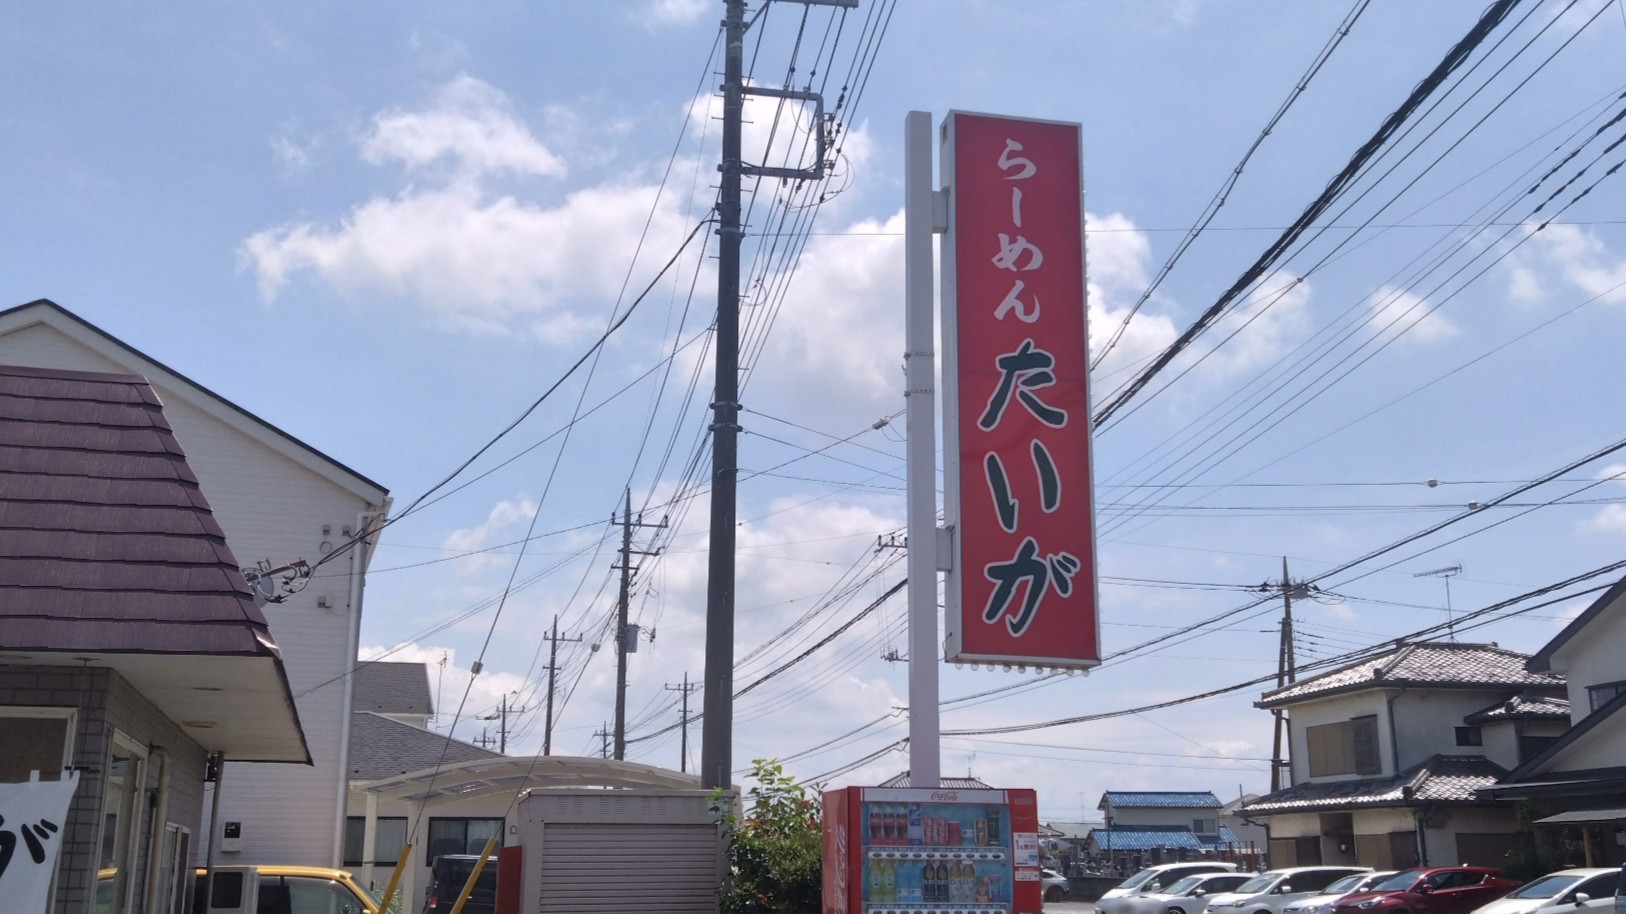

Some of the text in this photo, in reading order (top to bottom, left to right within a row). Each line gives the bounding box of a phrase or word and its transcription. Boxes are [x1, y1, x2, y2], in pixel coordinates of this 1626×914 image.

[977, 138, 1081, 637] らーめん たいが
